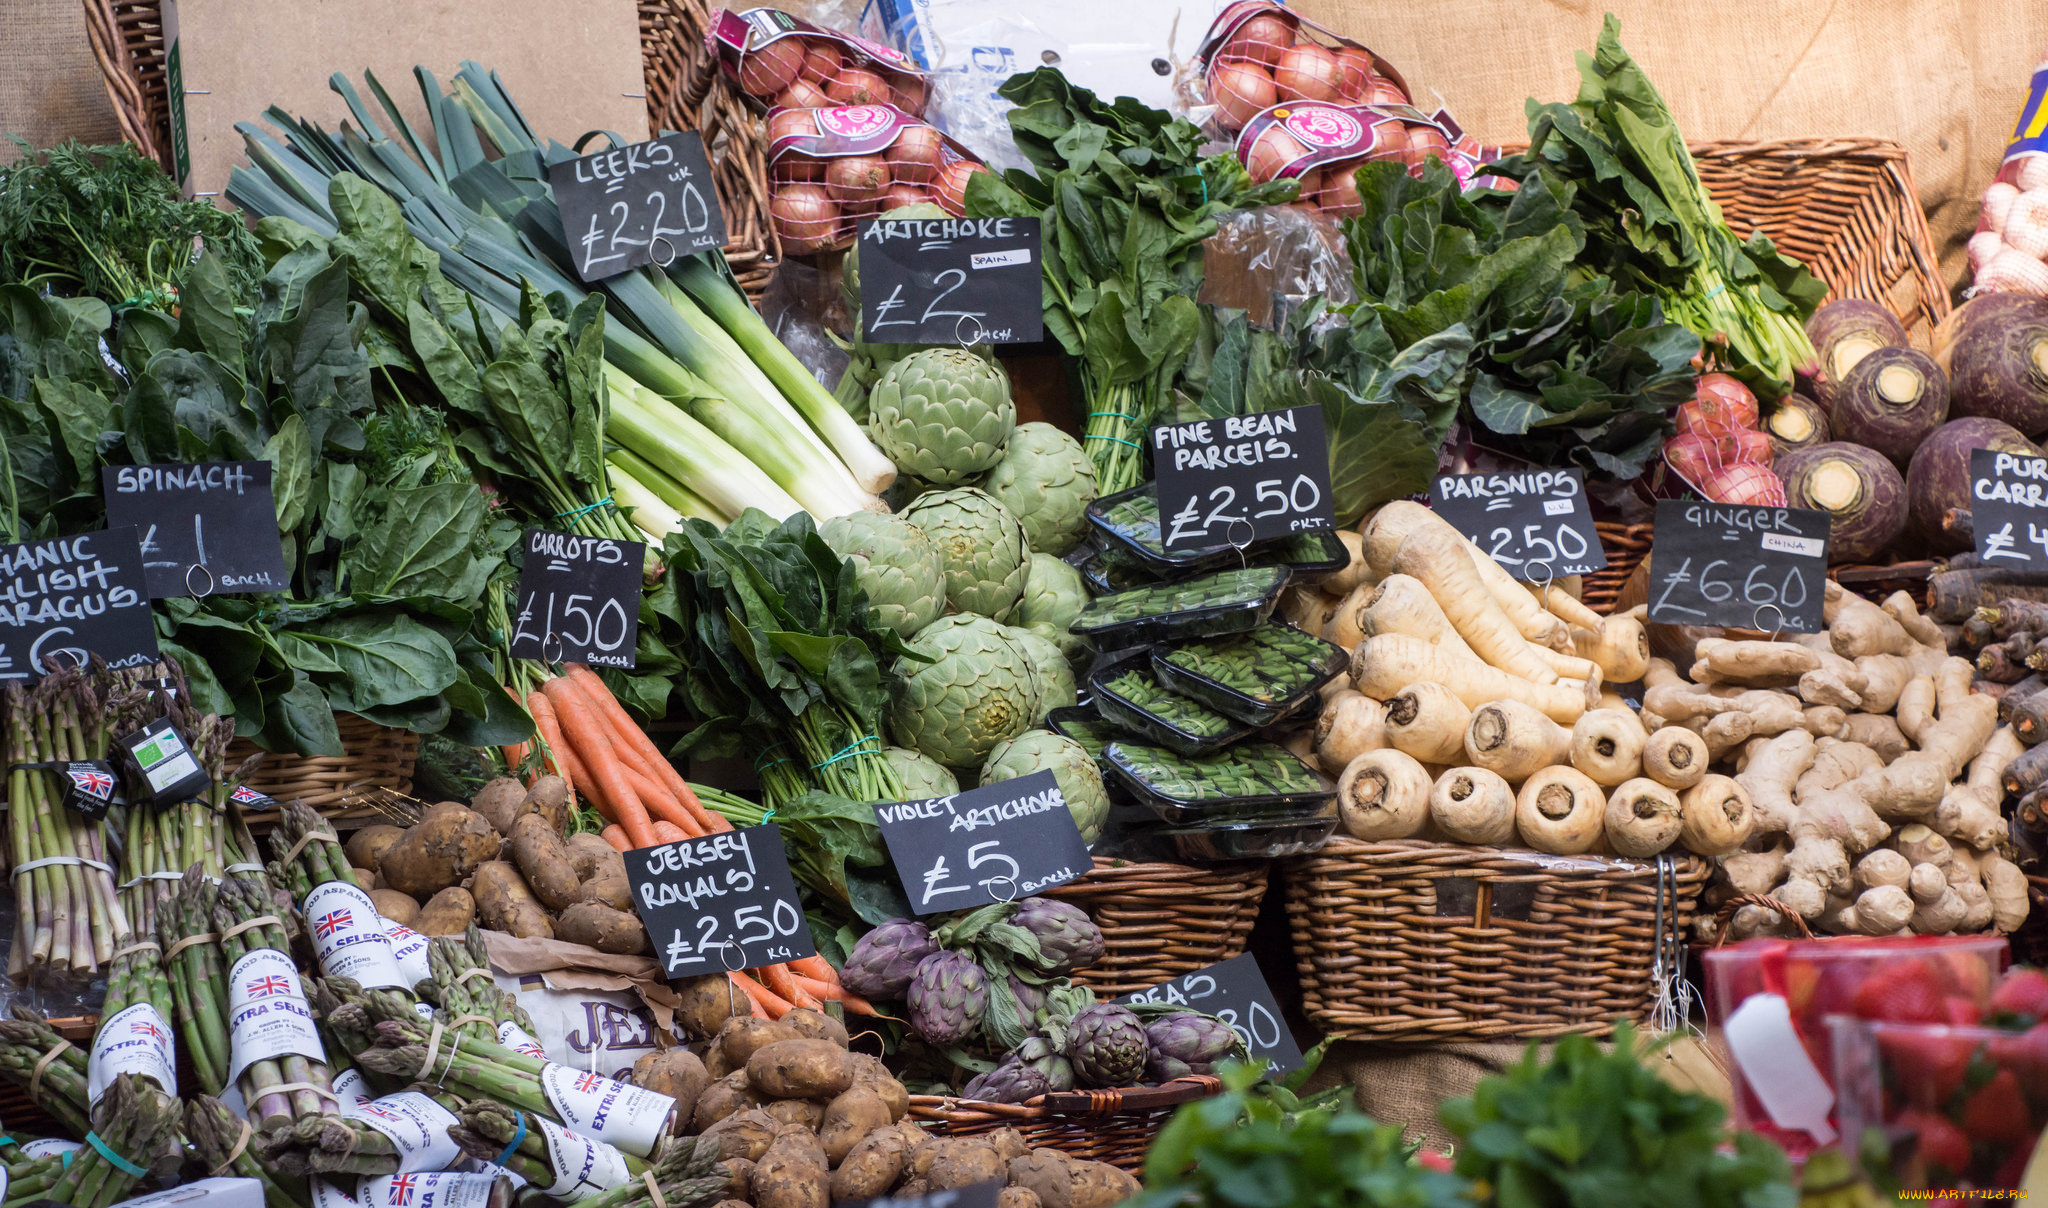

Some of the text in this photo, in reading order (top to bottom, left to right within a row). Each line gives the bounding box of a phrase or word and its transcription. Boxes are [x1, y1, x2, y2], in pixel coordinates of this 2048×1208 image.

[575, 141, 680, 183] LEEKS.
[582, 181, 709, 273] £2.20
[870, 268, 987, 333] £2
[1155, 409, 1297, 449] FINE BEAN
[117, 464, 254, 495] SPINACH
[1439, 470, 1579, 500] PARSNIPS
[1974, 478, 2048, 508] CARR
[1166, 474, 1321, 547] £2.50
[1290, 517, 1331, 531] PKT.
[531, 532, 629, 567] CARROTS.
[1470, 523, 1588, 565] 2.50
[1652, 557, 1807, 616] £6.60
[879, 794, 960, 825] VIOLET
[646, 832, 757, 875] JERSEY
[921, 840, 1020, 905] £5
[305, 894, 320, 921] OOD
[666, 899, 799, 972] £2.50
[230, 957, 258, 992] WOOD
[550, 1073, 580, 1124] PORTWOOD
[592, 1094, 618, 1131] EXTRA
